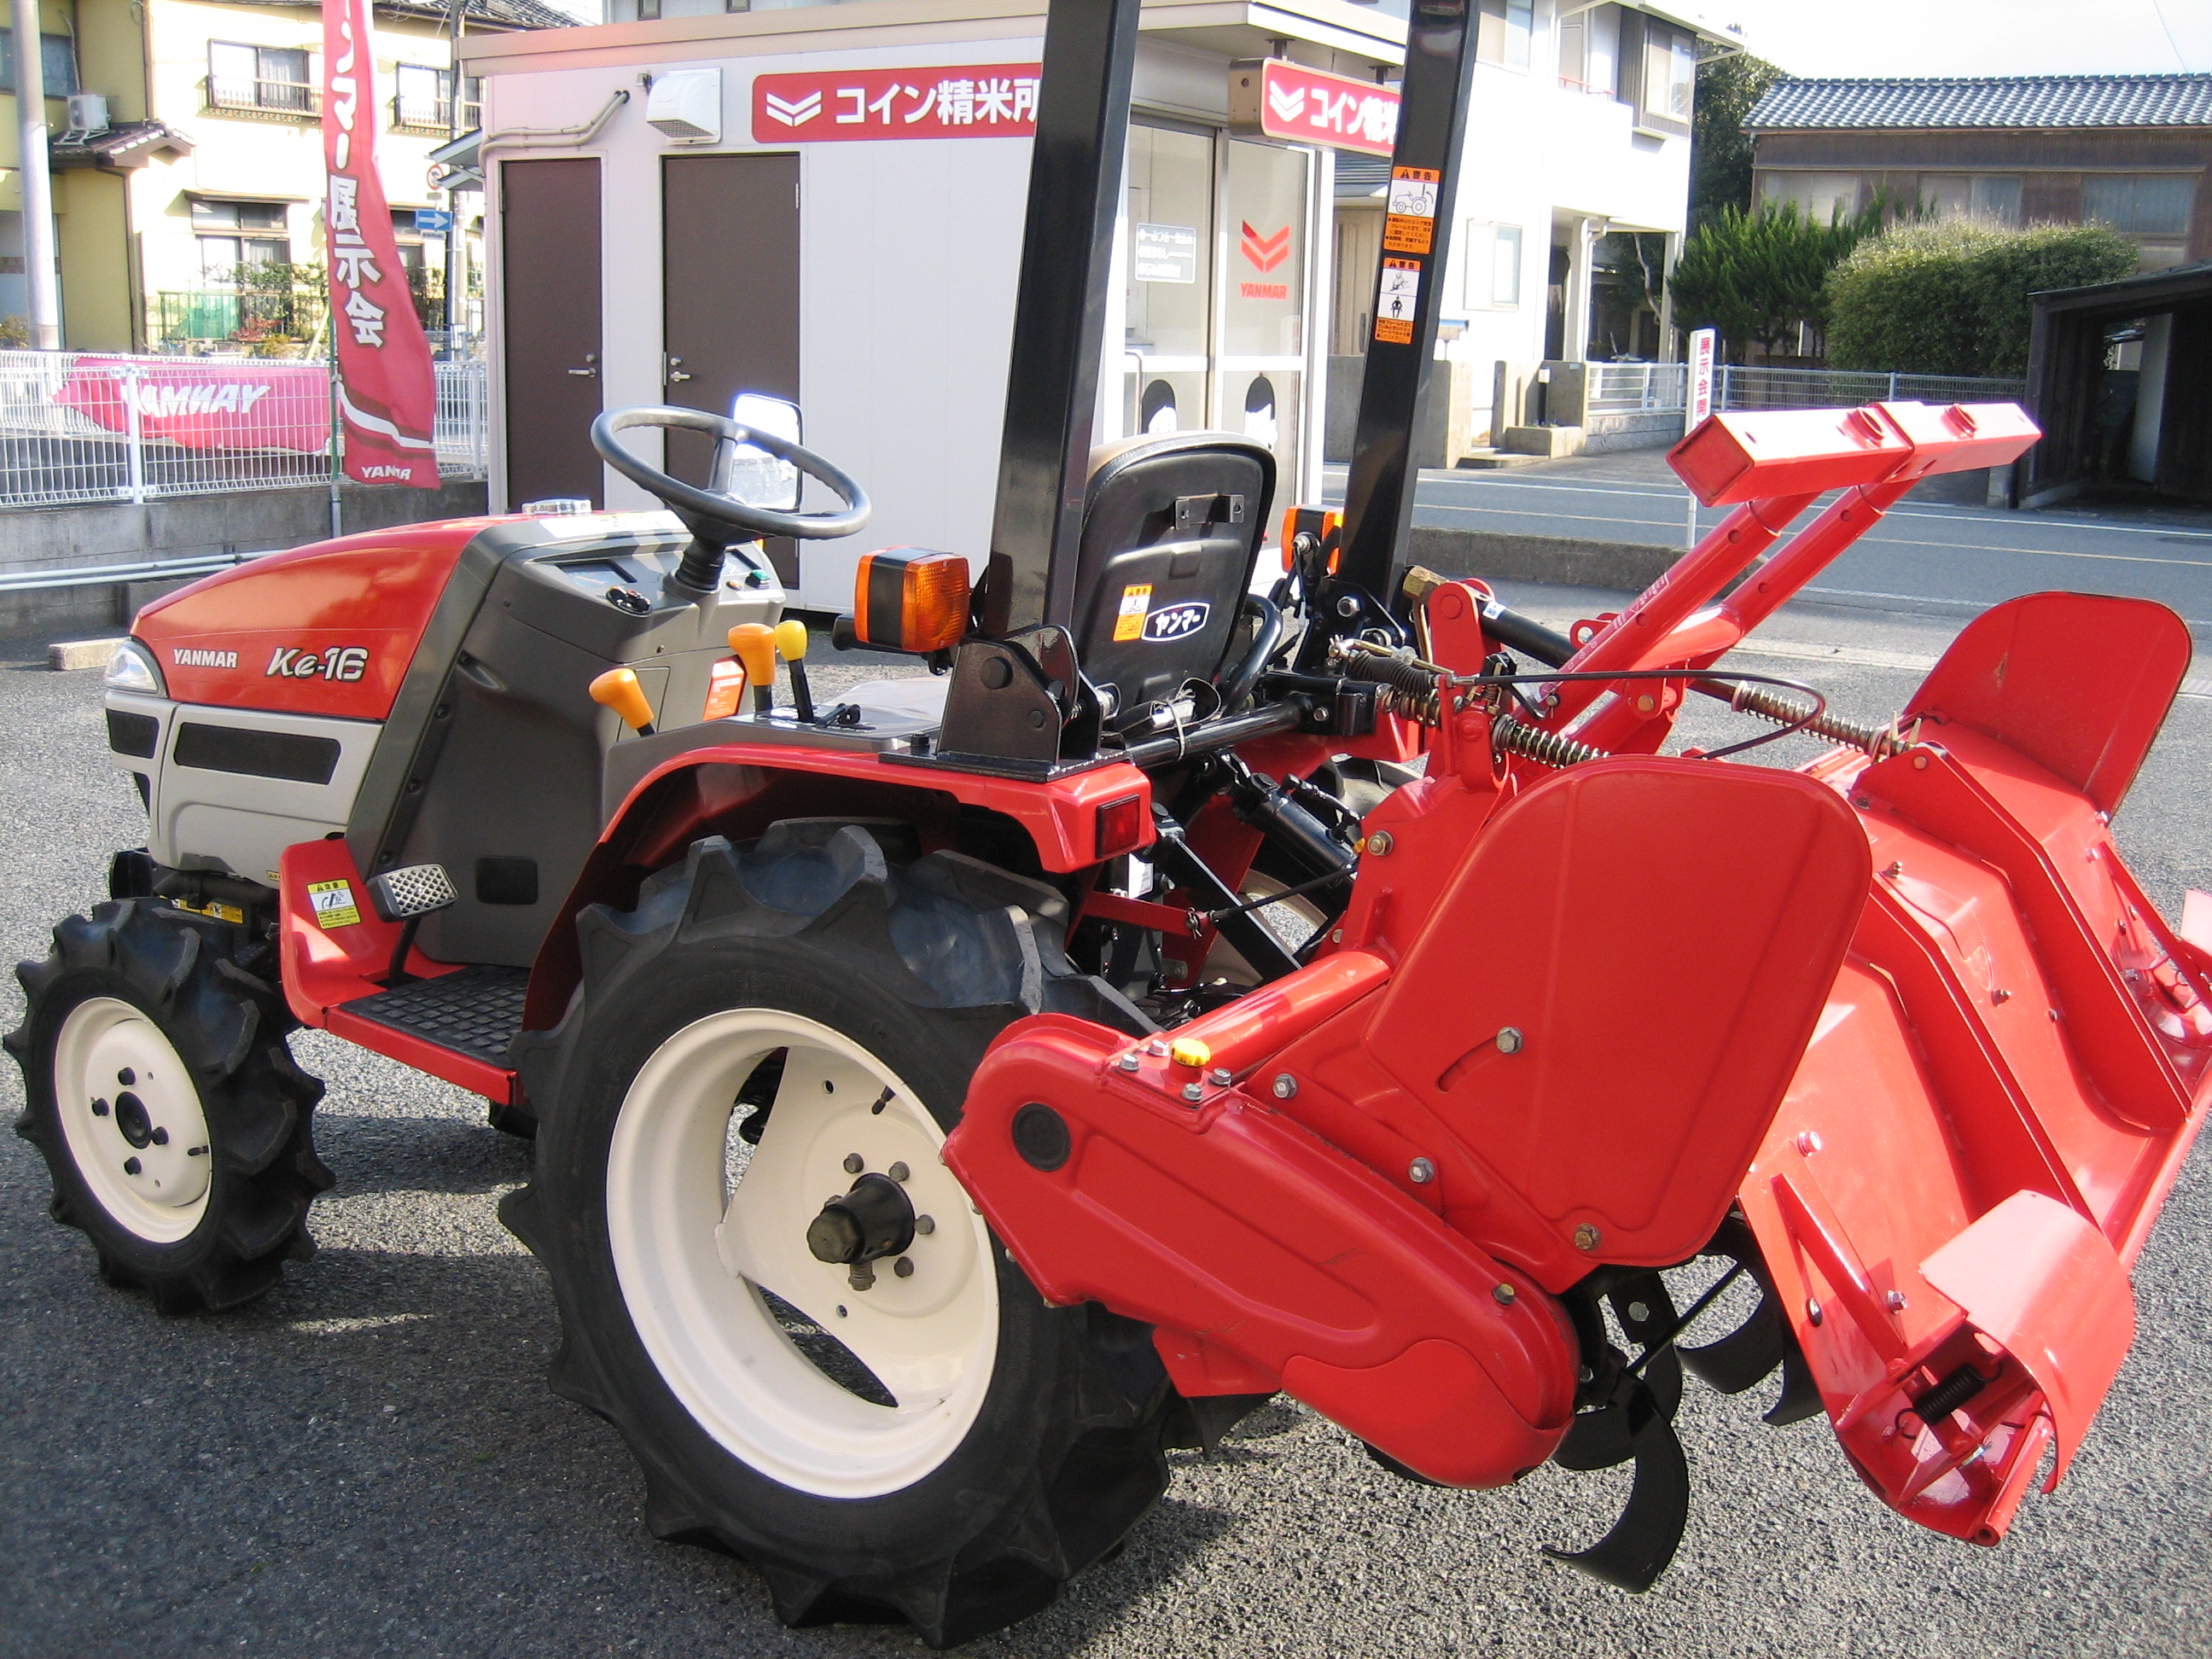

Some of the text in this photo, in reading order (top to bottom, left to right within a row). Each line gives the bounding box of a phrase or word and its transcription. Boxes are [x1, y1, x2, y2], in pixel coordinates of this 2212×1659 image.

[835, 76, 1042, 126] コイン精米所
[1240, 282, 1289, 300] YANMAR
[1696, 336, 1711, 425] 展示会開
[1155, 608, 1201, 637] ヤンマー
[173, 648, 238, 669] YANMAR
[265, 646, 369, 683] Ke-16
